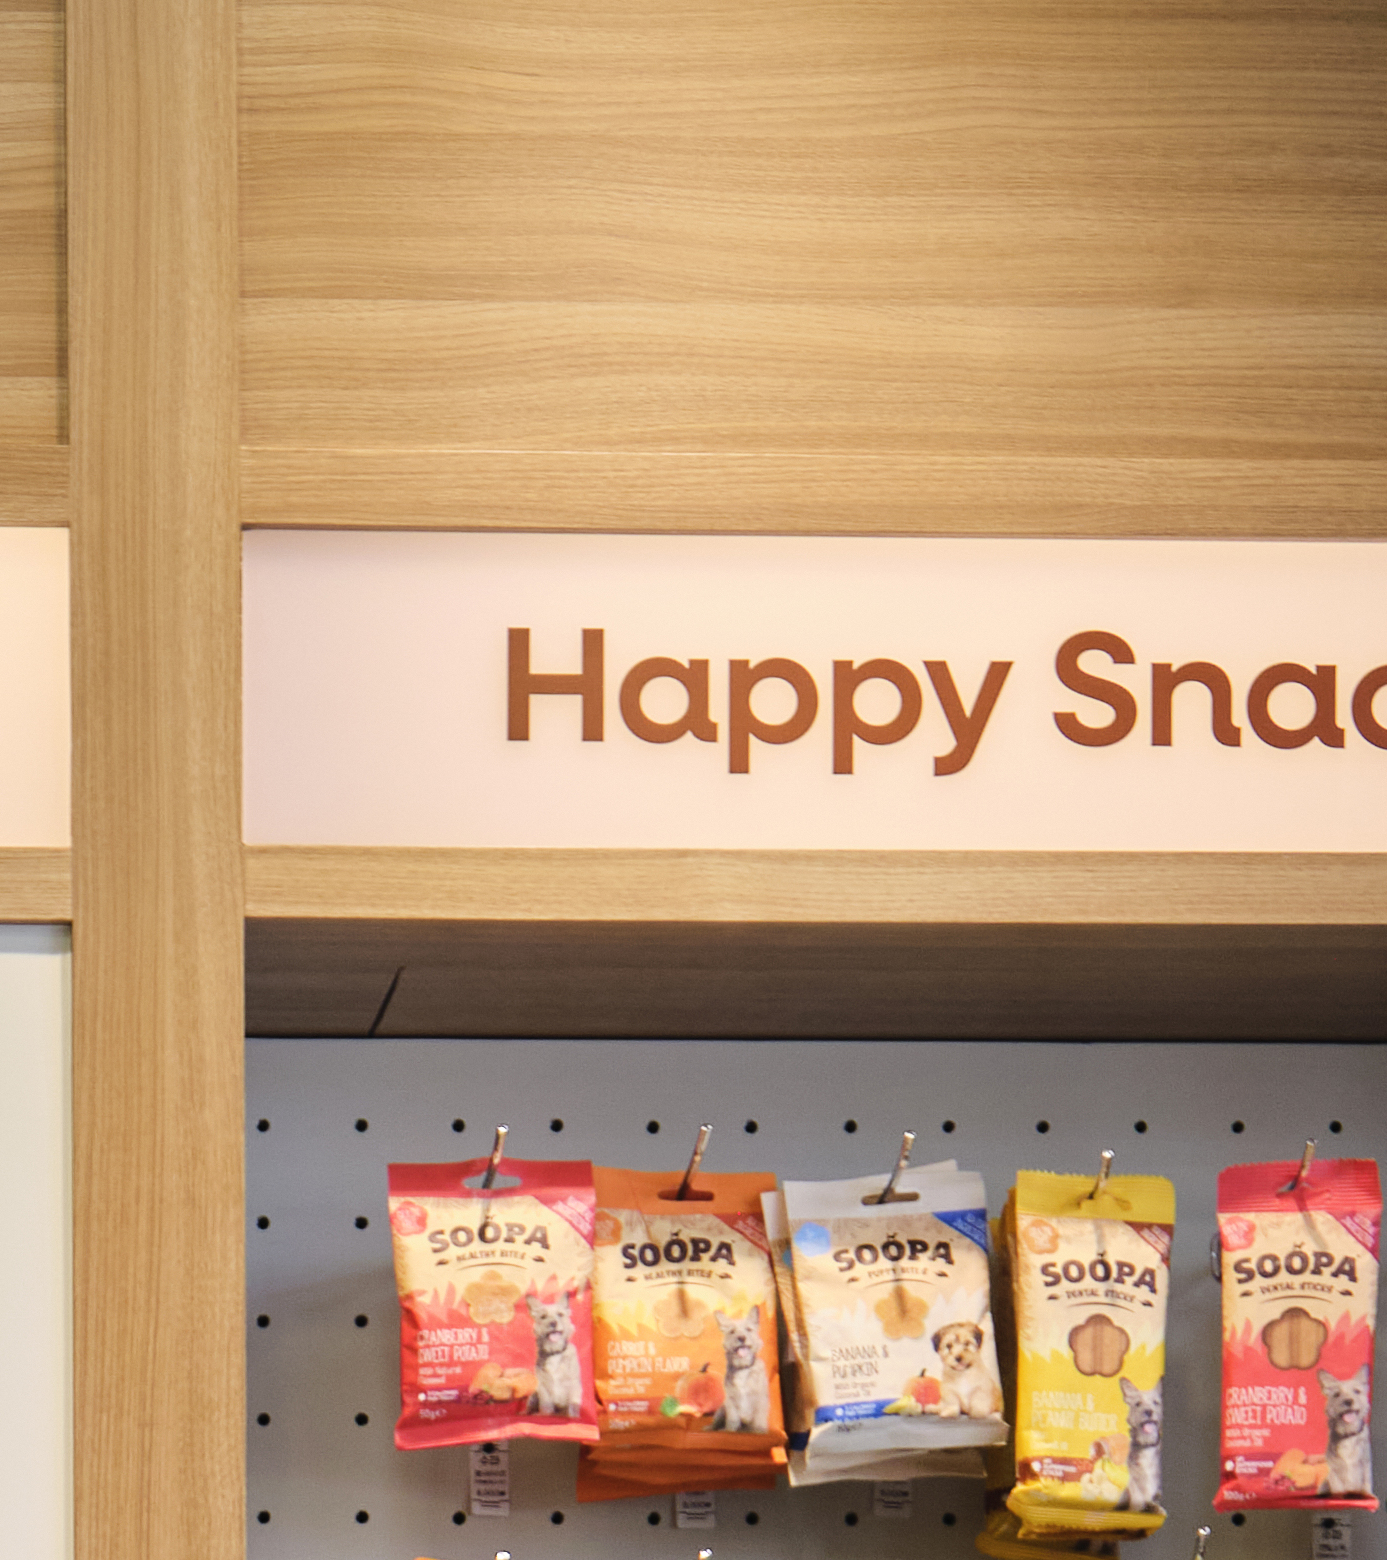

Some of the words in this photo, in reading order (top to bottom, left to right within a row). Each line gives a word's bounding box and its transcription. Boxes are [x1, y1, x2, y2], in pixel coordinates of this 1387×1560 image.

[507, 627, 1013, 776] Happy
[428, 1220, 550, 1254] SOOPA
[622, 1236, 735, 1269] SOOPA
[833, 1239, 954, 1273] SOOPA
[1233, 1251, 1358, 1284] SOOPA
[1040, 1259, 1157, 1294] SOOPA
[418, 1328, 476, 1344] CRANBERRY
[418, 1347, 450, 1363] SWEET
[454, 1345, 489, 1360] POTATO
[831, 1345, 876, 1362] BANANA
[1226, 1387, 1294, 1406] CRANBERRY
[1226, 1406, 1263, 1424] SWEET
[1267, 1406, 1307, 1424] POTATO
